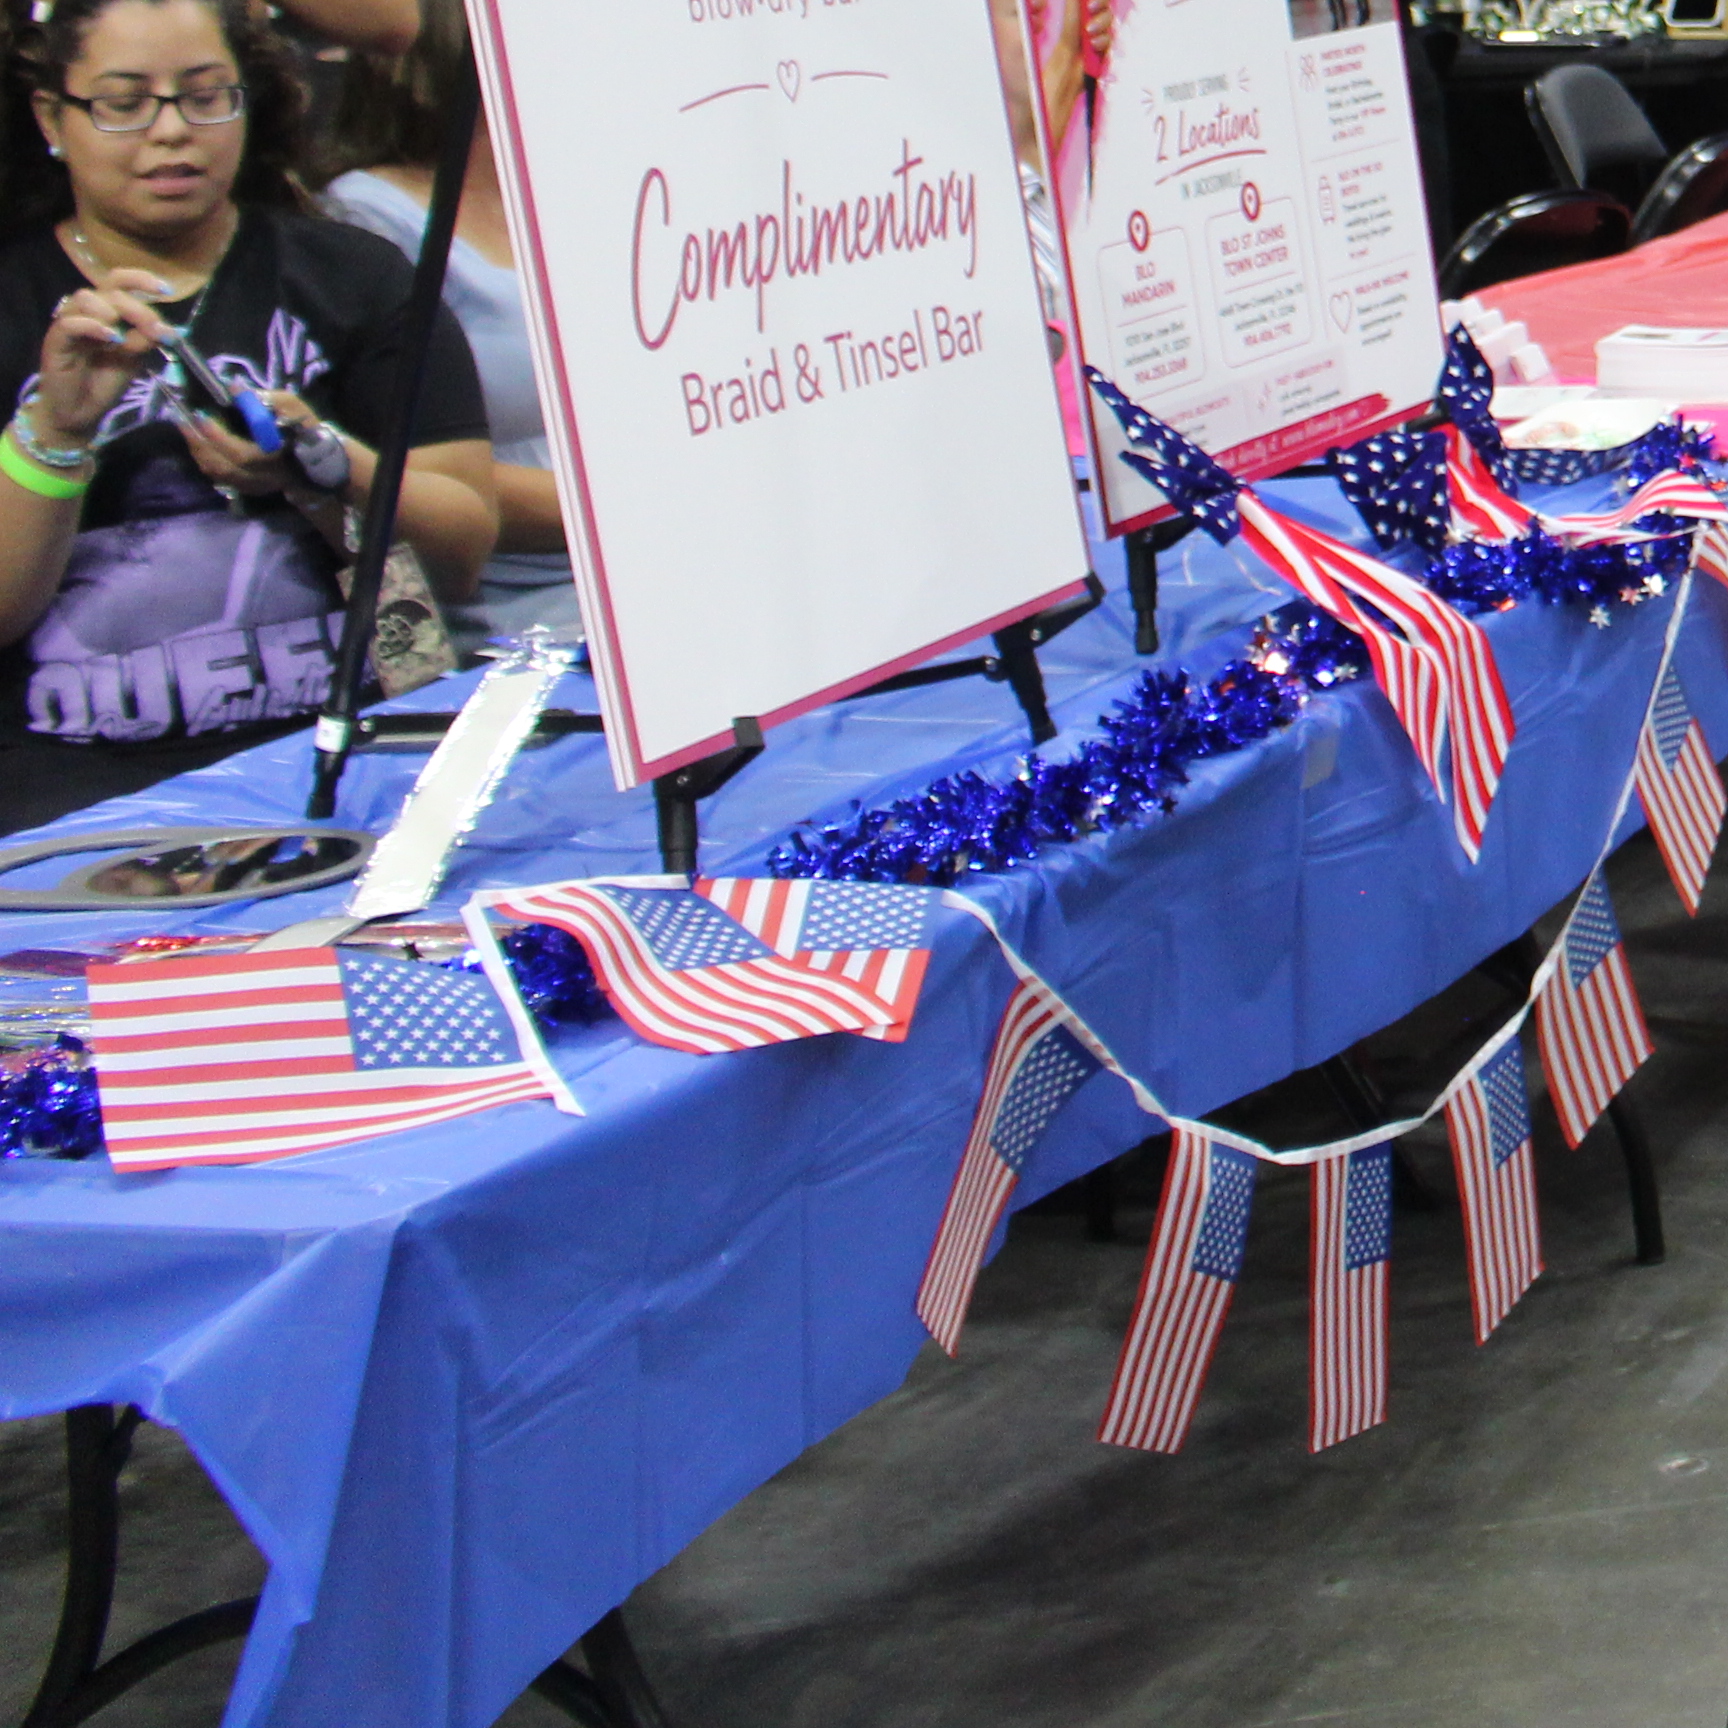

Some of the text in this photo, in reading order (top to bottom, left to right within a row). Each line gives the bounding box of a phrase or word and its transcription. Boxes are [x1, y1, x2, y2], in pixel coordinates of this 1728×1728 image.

[1153, 102, 1260, 163] 2 Locations
[631, 138, 978, 352] Complimentary
[679, 304, 986, 437] Braid & Tinsel Bar
